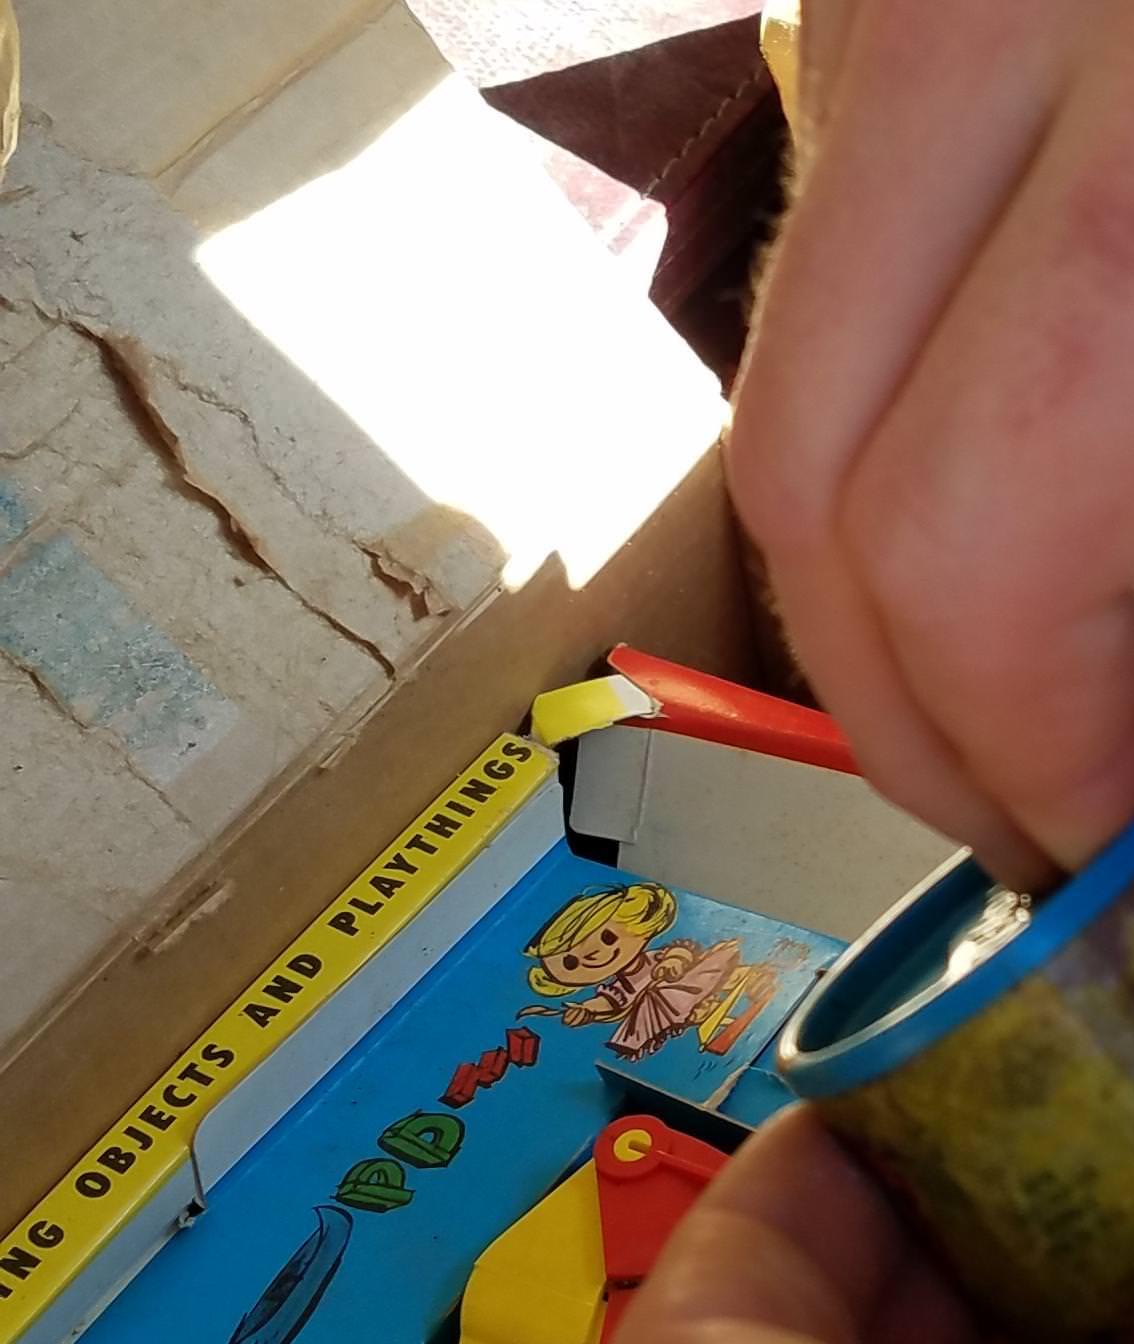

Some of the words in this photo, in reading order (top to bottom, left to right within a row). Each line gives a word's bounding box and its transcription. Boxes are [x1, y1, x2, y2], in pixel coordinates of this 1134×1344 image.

[74, 1042, 235, 1199] OBJECTS
[242, 953, 323, 1029] AND
[327, 741, 533, 936] PLAYTHINGS
